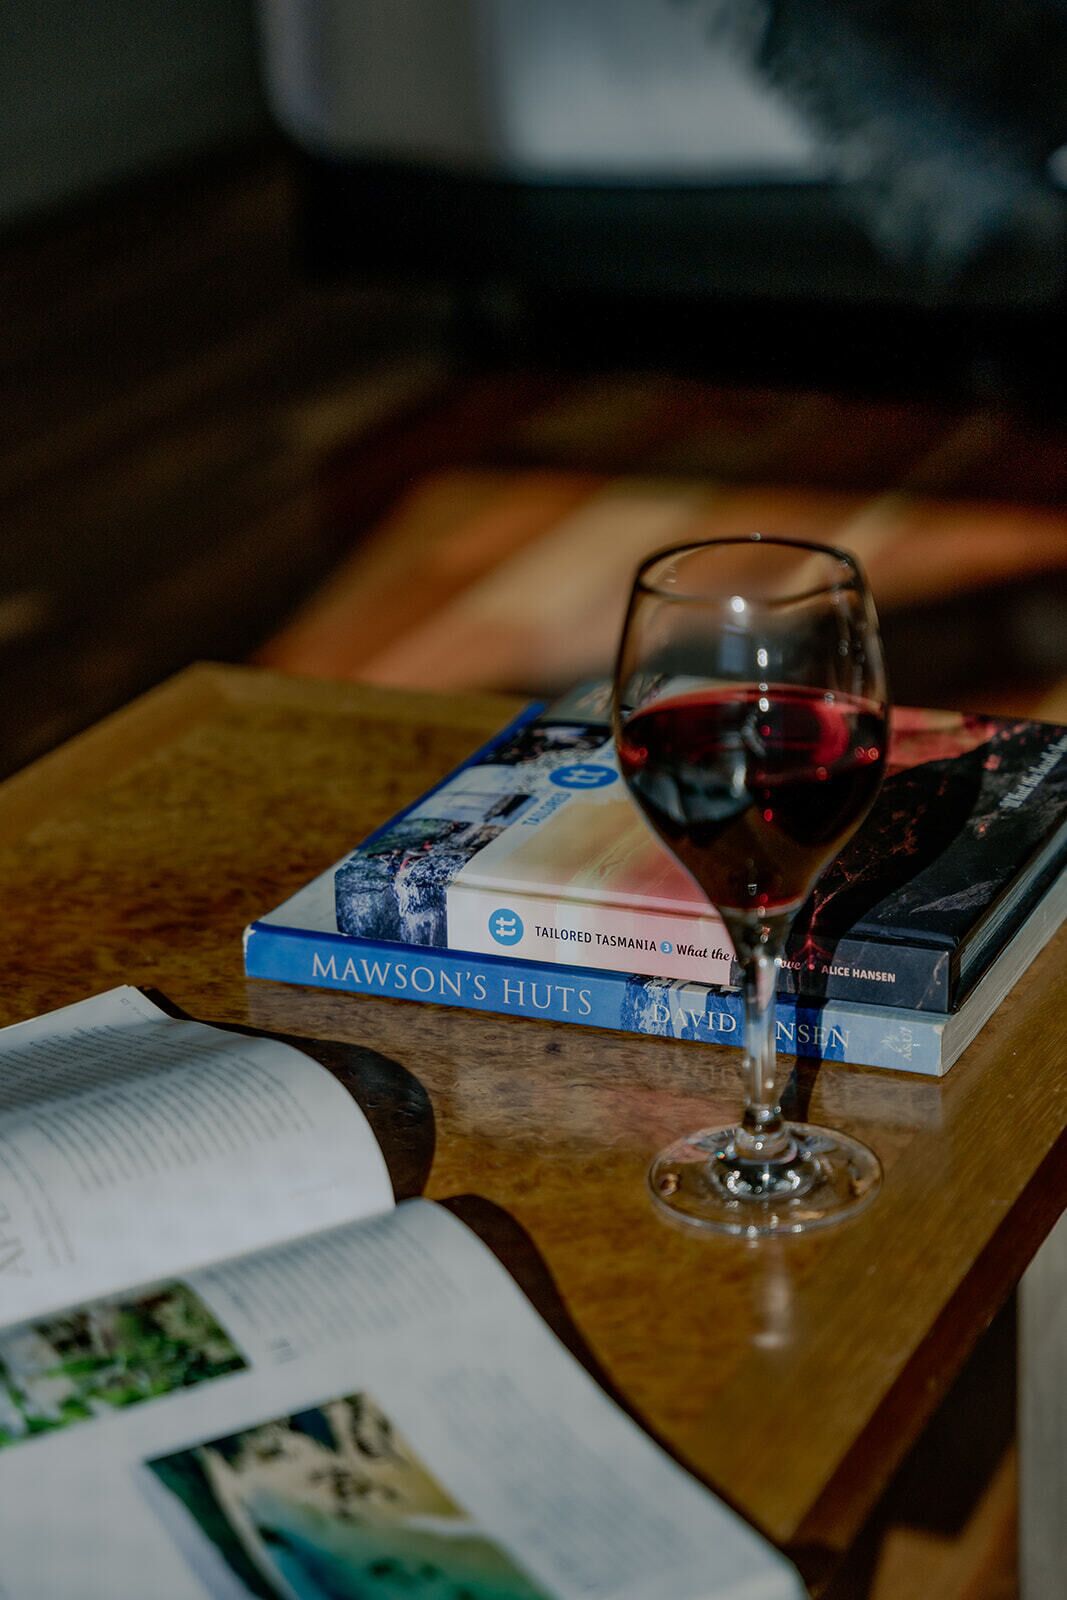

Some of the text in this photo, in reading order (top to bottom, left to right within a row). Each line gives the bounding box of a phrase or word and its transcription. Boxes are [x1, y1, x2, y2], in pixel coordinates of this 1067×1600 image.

[535, 926, 592, 943] TAILORED
[596, 933, 657, 952] TASMANIA
[663, 943, 671, 952] 3
[676, 943, 708, 959] What
[712, 947, 730, 961] the
[821, 964, 850, 977] ALICE
[852, 969, 896, 983] HANSEN
[312, 952, 850, 1049] MAWSON'S HUTS DAVID NSEN
